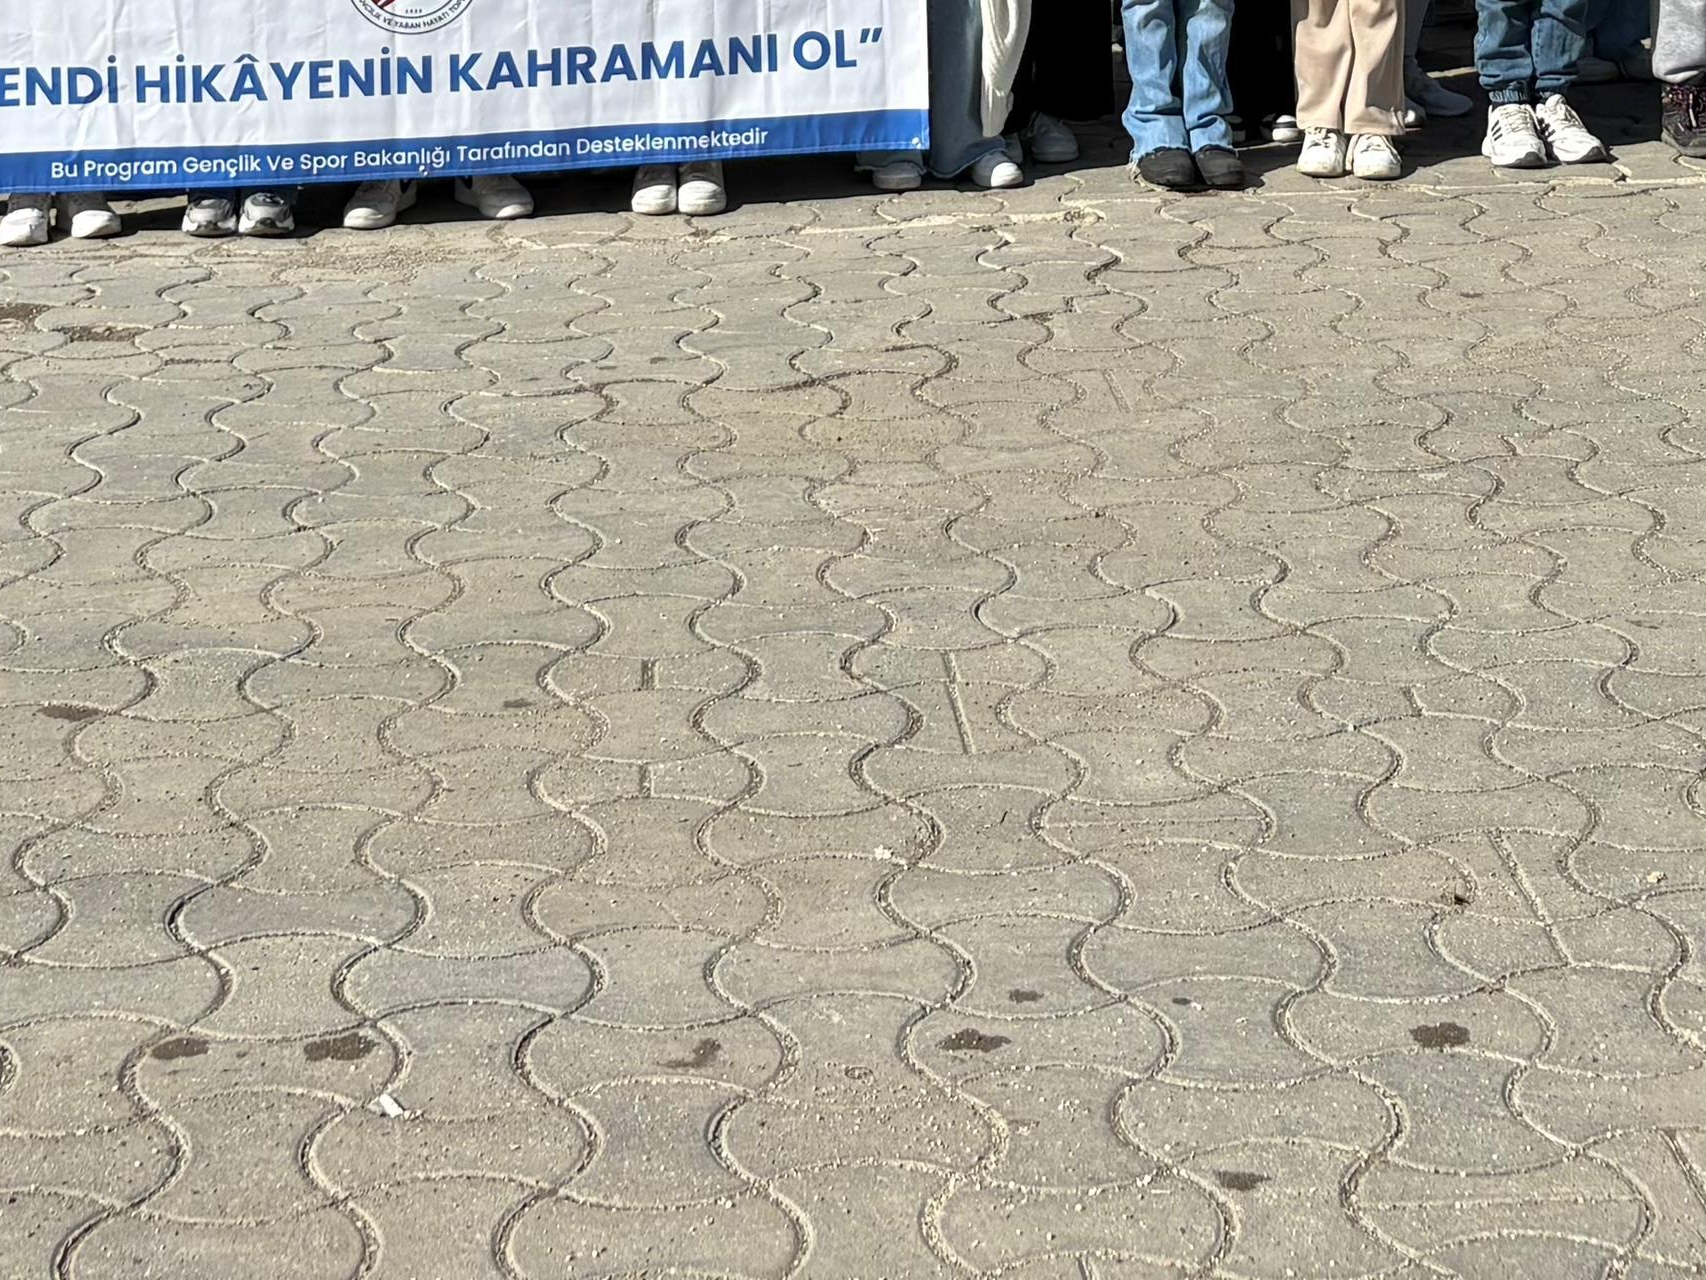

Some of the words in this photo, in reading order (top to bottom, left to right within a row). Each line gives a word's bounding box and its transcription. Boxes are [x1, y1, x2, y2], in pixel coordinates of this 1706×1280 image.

[136, 46, 433, 103] HİKÂYENİN
[449, 33, 778, 93] KAHRAMANI
[793, 27, 883, 71] OL”
[52, 159, 78, 179] Bu
[84, 157, 177, 180] Program
[183, 152, 262, 177] Gençlik
[266, 153, 294, 170] Ve
[299, 151, 349, 173] Spor
[354, 143, 451, 168] Bakanlığı
[456, 139, 571, 161] Tarafından
[576, 128, 769, 156] Desteklenmektedir
